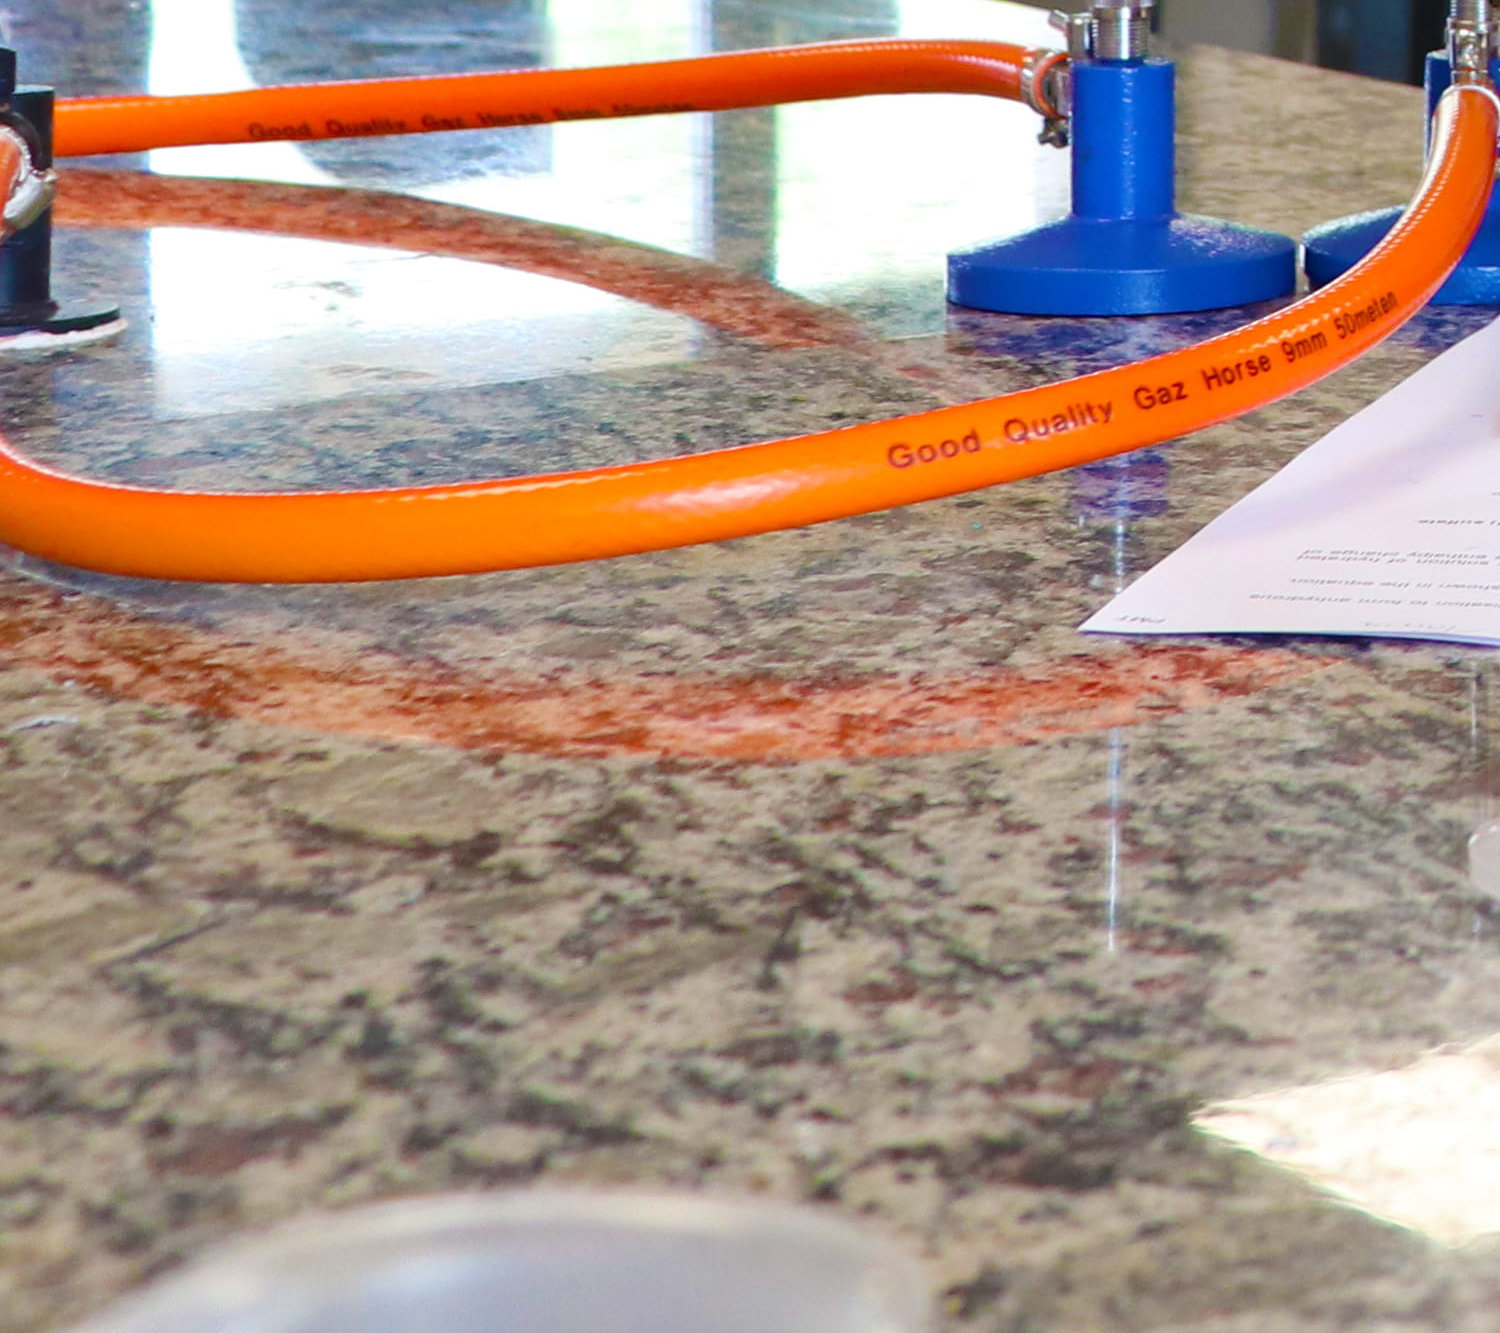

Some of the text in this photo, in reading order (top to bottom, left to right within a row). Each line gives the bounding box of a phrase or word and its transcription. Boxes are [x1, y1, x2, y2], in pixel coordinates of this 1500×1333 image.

[887, 427, 981, 469] Good
[1003, 400, 1113, 442] Quality
[1133, 381, 1189, 410] Gaz
[1200, 354, 1272, 390] Horse
[1281, 331, 1328, 363] 9mm
